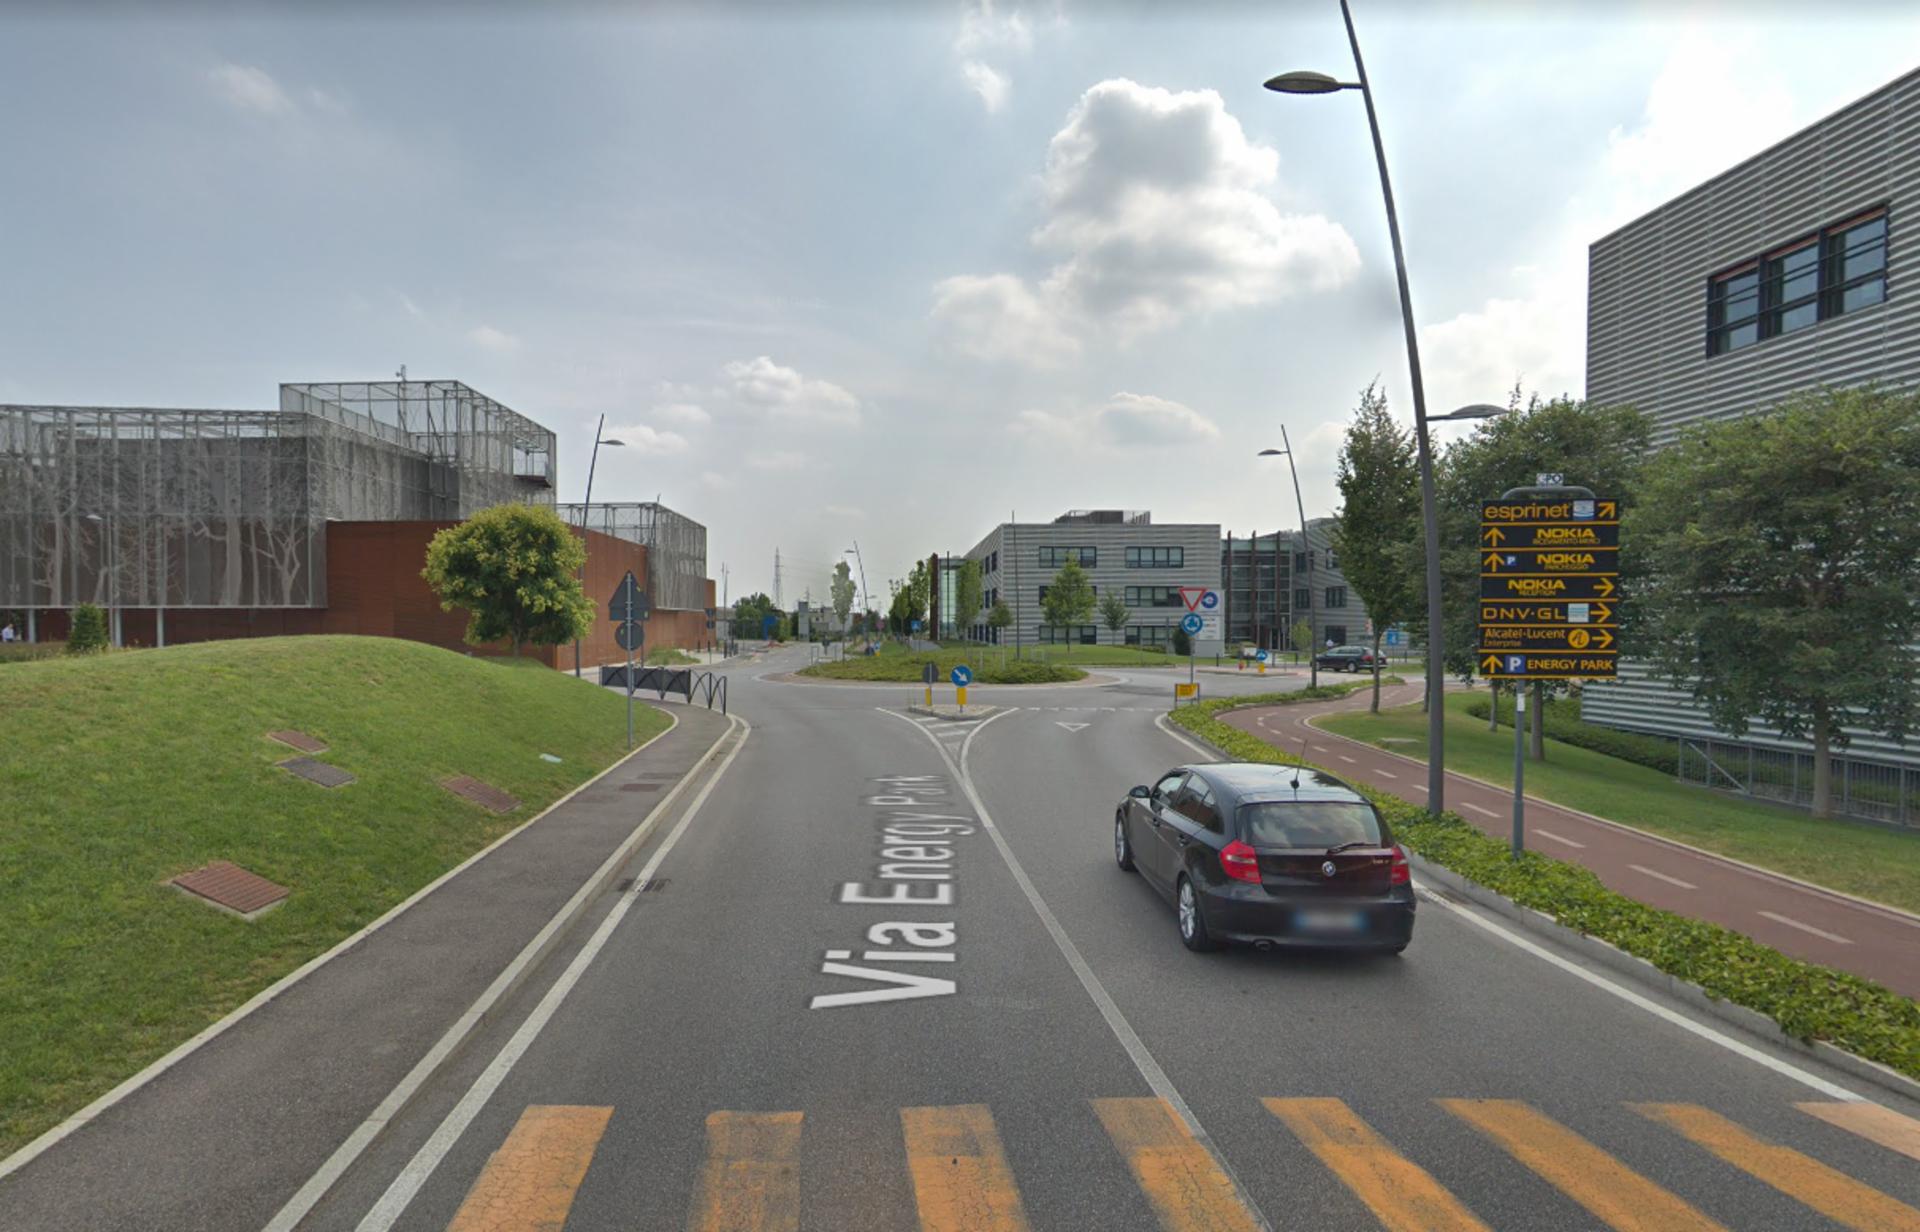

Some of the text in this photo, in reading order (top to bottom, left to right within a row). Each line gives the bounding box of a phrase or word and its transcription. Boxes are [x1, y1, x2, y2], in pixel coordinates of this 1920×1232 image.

[1484, 503, 1569, 521] esprinet
[1537, 528, 1595, 538] NOKIA
[1537, 554, 1595, 564] NOKIA
[1508, 579, 1566, 590] NOKIA
[1527, 659, 1577, 670] ENERGY
[1581, 658, 1613, 670] PARK
